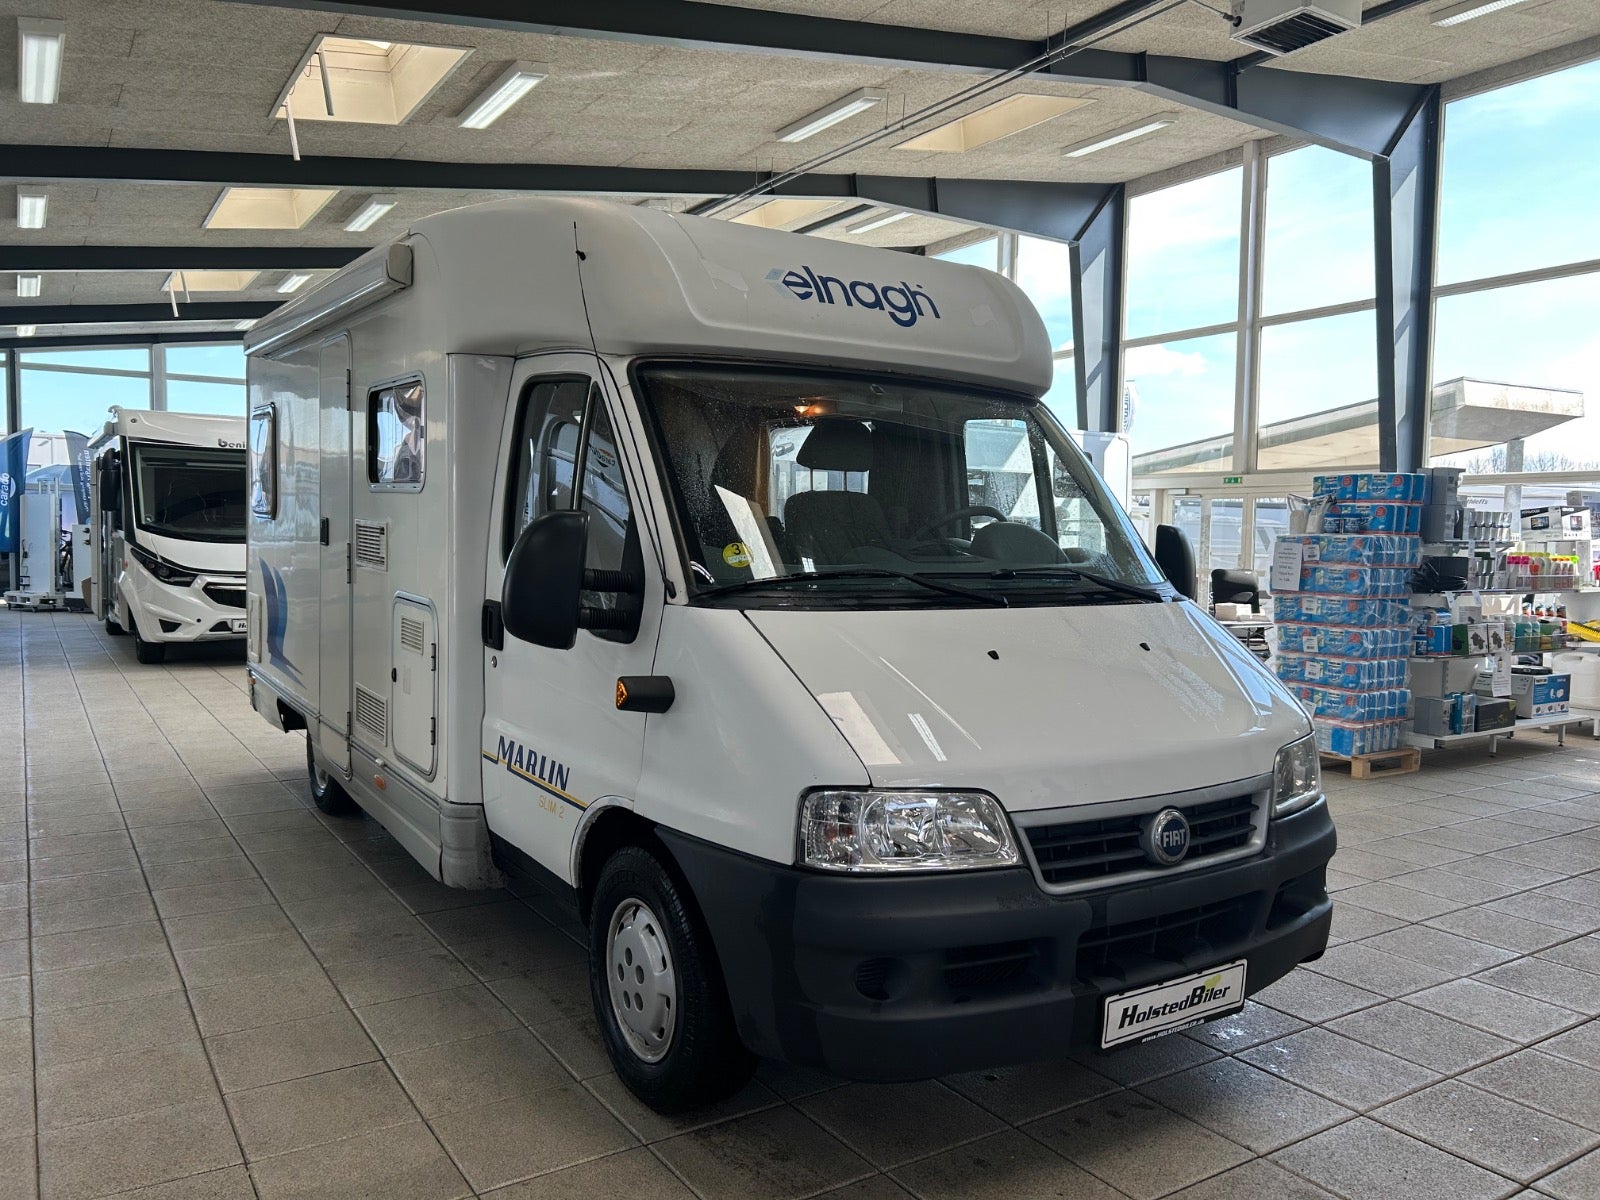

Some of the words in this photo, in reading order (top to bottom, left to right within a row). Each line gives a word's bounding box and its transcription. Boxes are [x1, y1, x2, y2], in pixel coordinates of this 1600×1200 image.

[782, 265, 941, 328] elnagh
[0, 472, 10, 506] carado
[497, 735, 570, 792] MARLIN
[539, 795, 556, 814] SLIM
[1162, 828, 1186, 848] FIAT
[1118, 984, 1231, 1030] HolstedBiler
